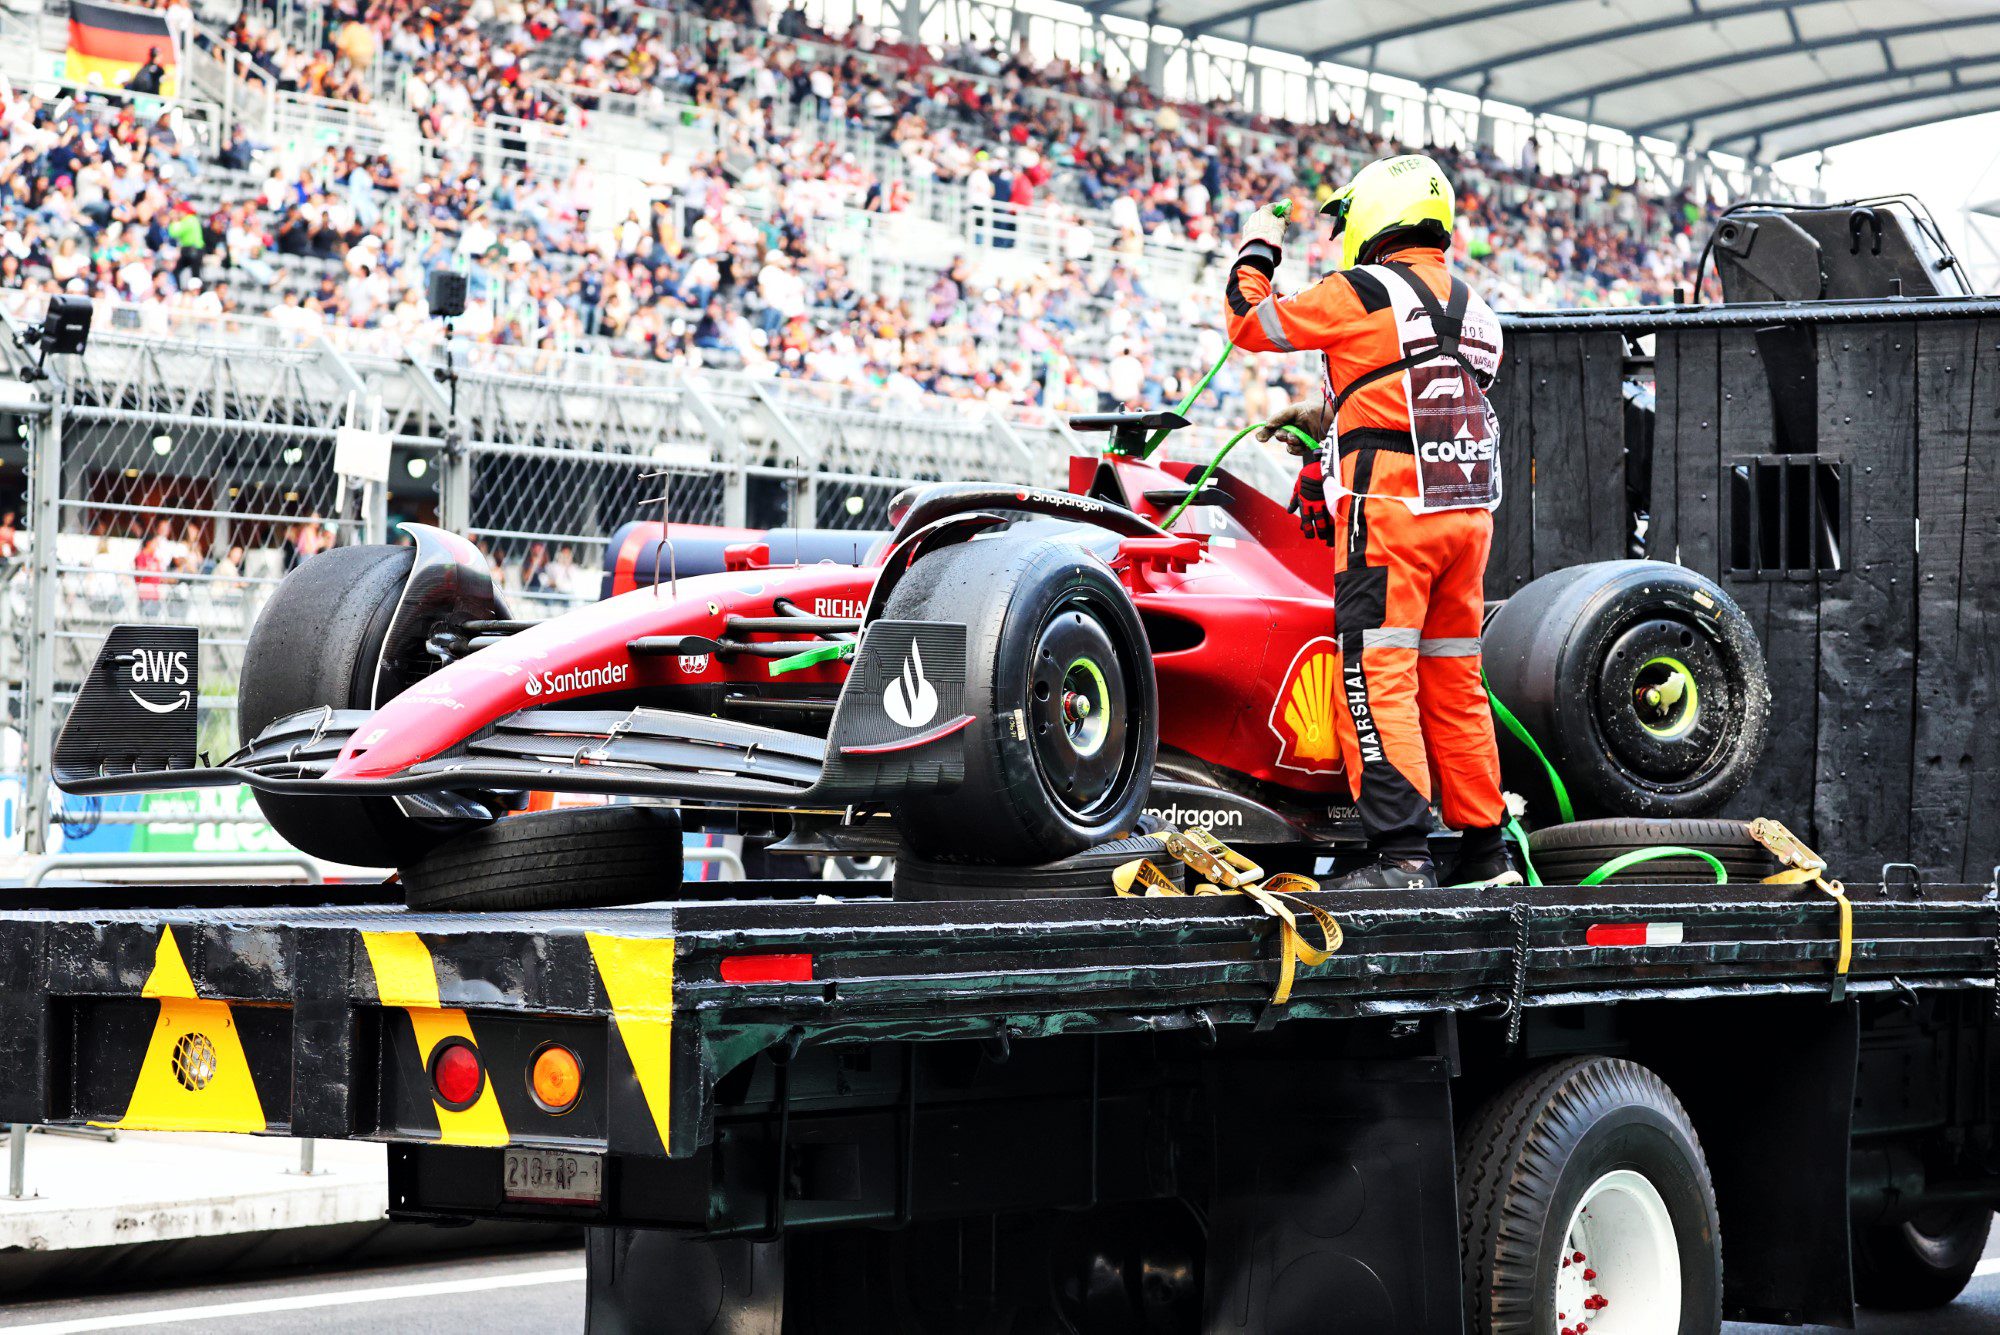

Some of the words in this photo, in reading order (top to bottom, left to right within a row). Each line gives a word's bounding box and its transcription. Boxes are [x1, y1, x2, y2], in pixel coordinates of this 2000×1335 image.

[1421, 438, 1493, 463] COURS
[1032, 490, 1104, 513] Snapdragon
[815, 598, 867, 618] RICHA
[131, 648, 189, 685] aws
[544, 663, 629, 694] Santander
[1344, 662, 1383, 762] MARSHAL
[1142, 803, 1243, 831] dragon
